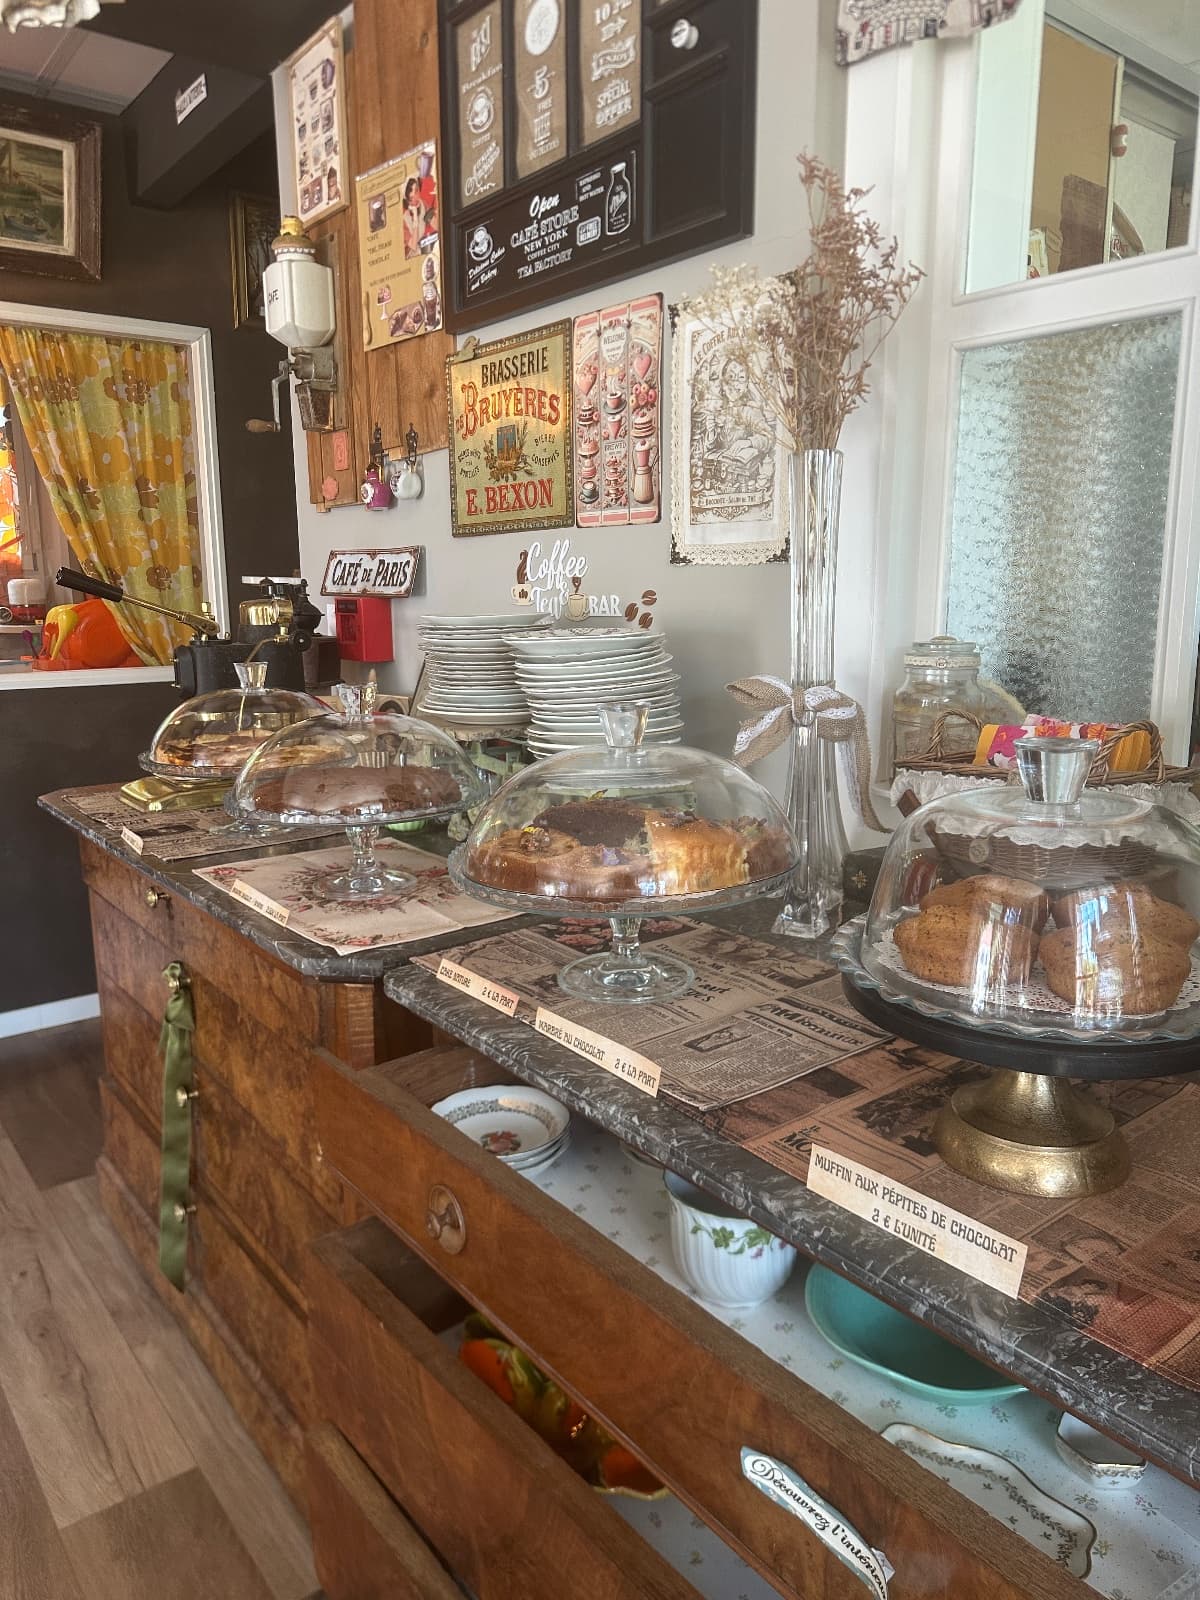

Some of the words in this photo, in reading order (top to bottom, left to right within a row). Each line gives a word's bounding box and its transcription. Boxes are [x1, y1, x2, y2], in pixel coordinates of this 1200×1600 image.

[595, 97, 633, 126] OFFER
[597, 81, 632, 108] SPECIAL
[528, 193, 561, 218] Open
[510, 222, 541, 248] CAFÉ
[541, 205, 580, 236] STORE
[523, 238, 543, 255] NEW
[544, 226, 569, 247] YORK
[516, 266, 535, 280] TEA
[534, 248, 574, 274] FACTORY
[702, 330, 726, 357] COFFRE
[481, 346, 549, 388] BRASSERIE
[461, 379, 561, 442] BRUYÈRES
[465, 488, 483, 516] E.
[485, 477, 554, 514] BEXON
[332, 557, 363, 586] CAFÉ
[372, 558, 410, 587] PARIS
[526, 539, 589, 591] Coffee
[531, 586, 562, 620] Tea
[589, 594, 623, 617] BAR
[481, 986, 488, 996] 2
[499, 994, 515, 1009] PART
[563, 1031, 574, 1045] AU
[573, 1036, 606, 1062] CHOCOLAT
[614, 1057, 622, 1070] 2
[627, 1063, 638, 1080] LA
[637, 1069, 658, 1090] PART
[815, 1153, 852, 1184] MUFFIN
[854, 1172, 879, 1196] AUX
[881, 1187, 928, 1222] PÉPITES
[930, 1208, 947, 1231] DE
[949, 1219, 1018, 1265] CHOCOLAT
[871, 1207, 881, 1223] 2
[883, 1213, 892, 1230] €
[892, 1219, 938, 1254] L'UNITÉ
[749, 1458, 831, 1532] Découvrez
